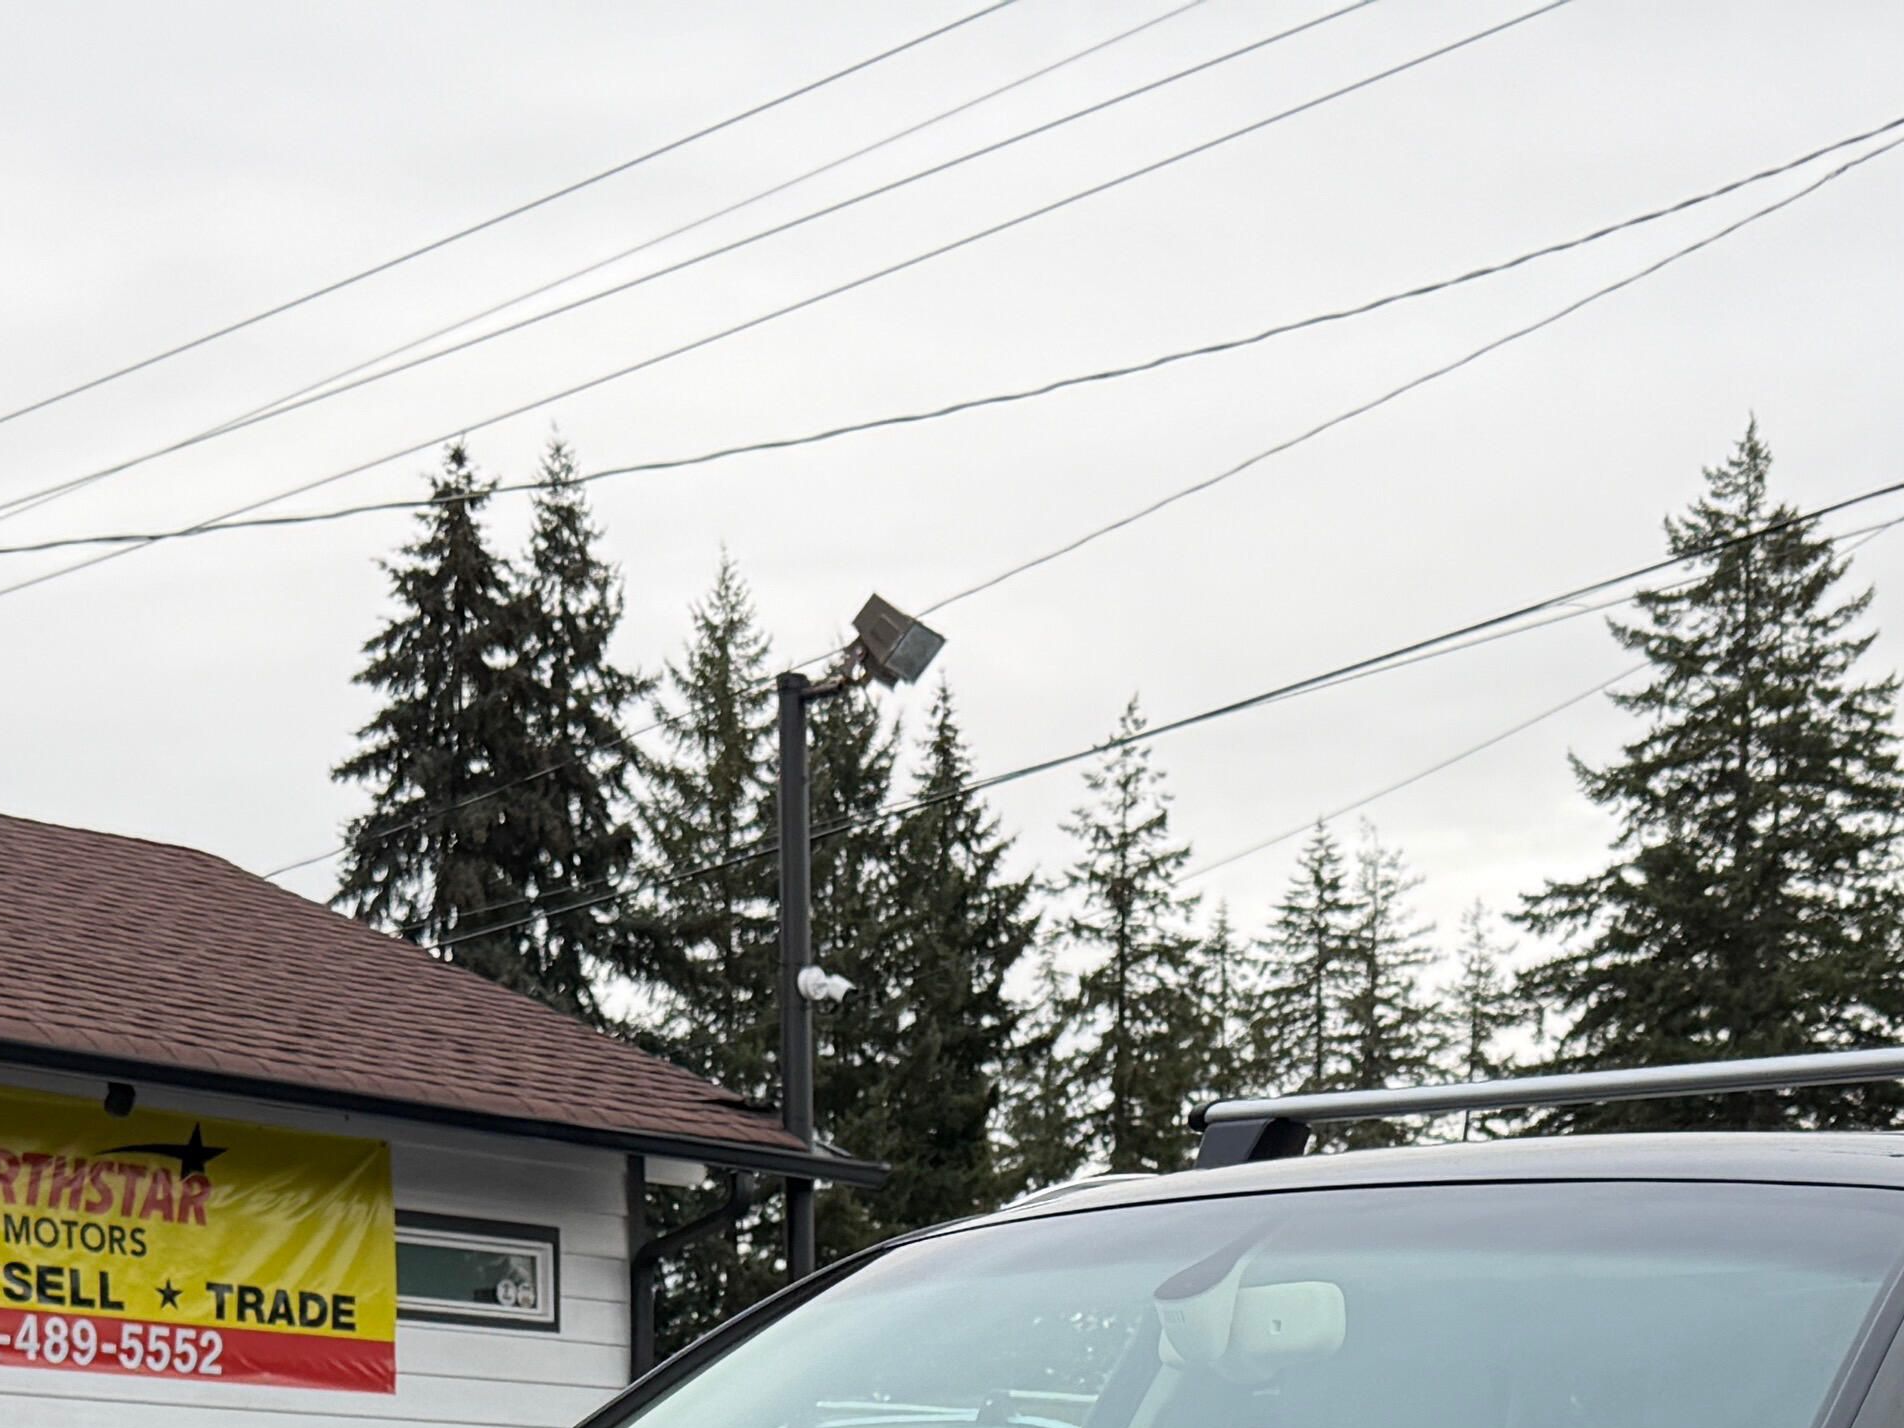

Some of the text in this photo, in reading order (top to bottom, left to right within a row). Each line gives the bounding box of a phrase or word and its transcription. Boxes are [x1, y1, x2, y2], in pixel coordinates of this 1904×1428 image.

[3, 1212, 148, 1258] MOTORS
[3, 1262, 124, 1311] SELL
[205, 1281, 357, 1332] TRADE
